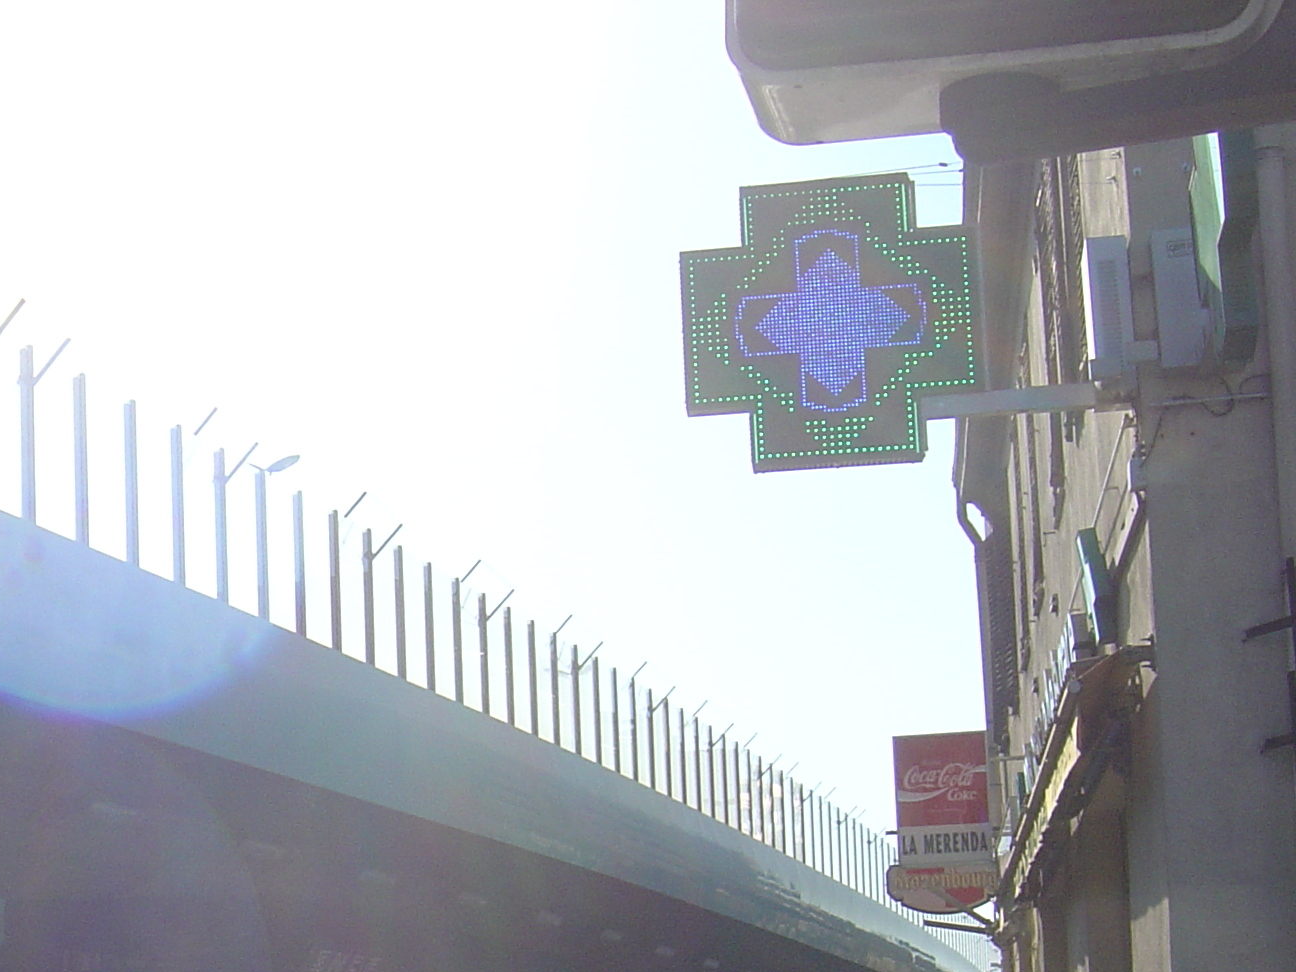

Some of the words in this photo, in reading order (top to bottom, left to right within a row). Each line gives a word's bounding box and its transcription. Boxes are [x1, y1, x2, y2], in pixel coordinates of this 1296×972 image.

[905, 763, 974, 790] Coca-Cola
[947, 789, 978, 801] Coke
[902, 834, 918, 855] LA
[923, 831, 989, 855] MERENDA
